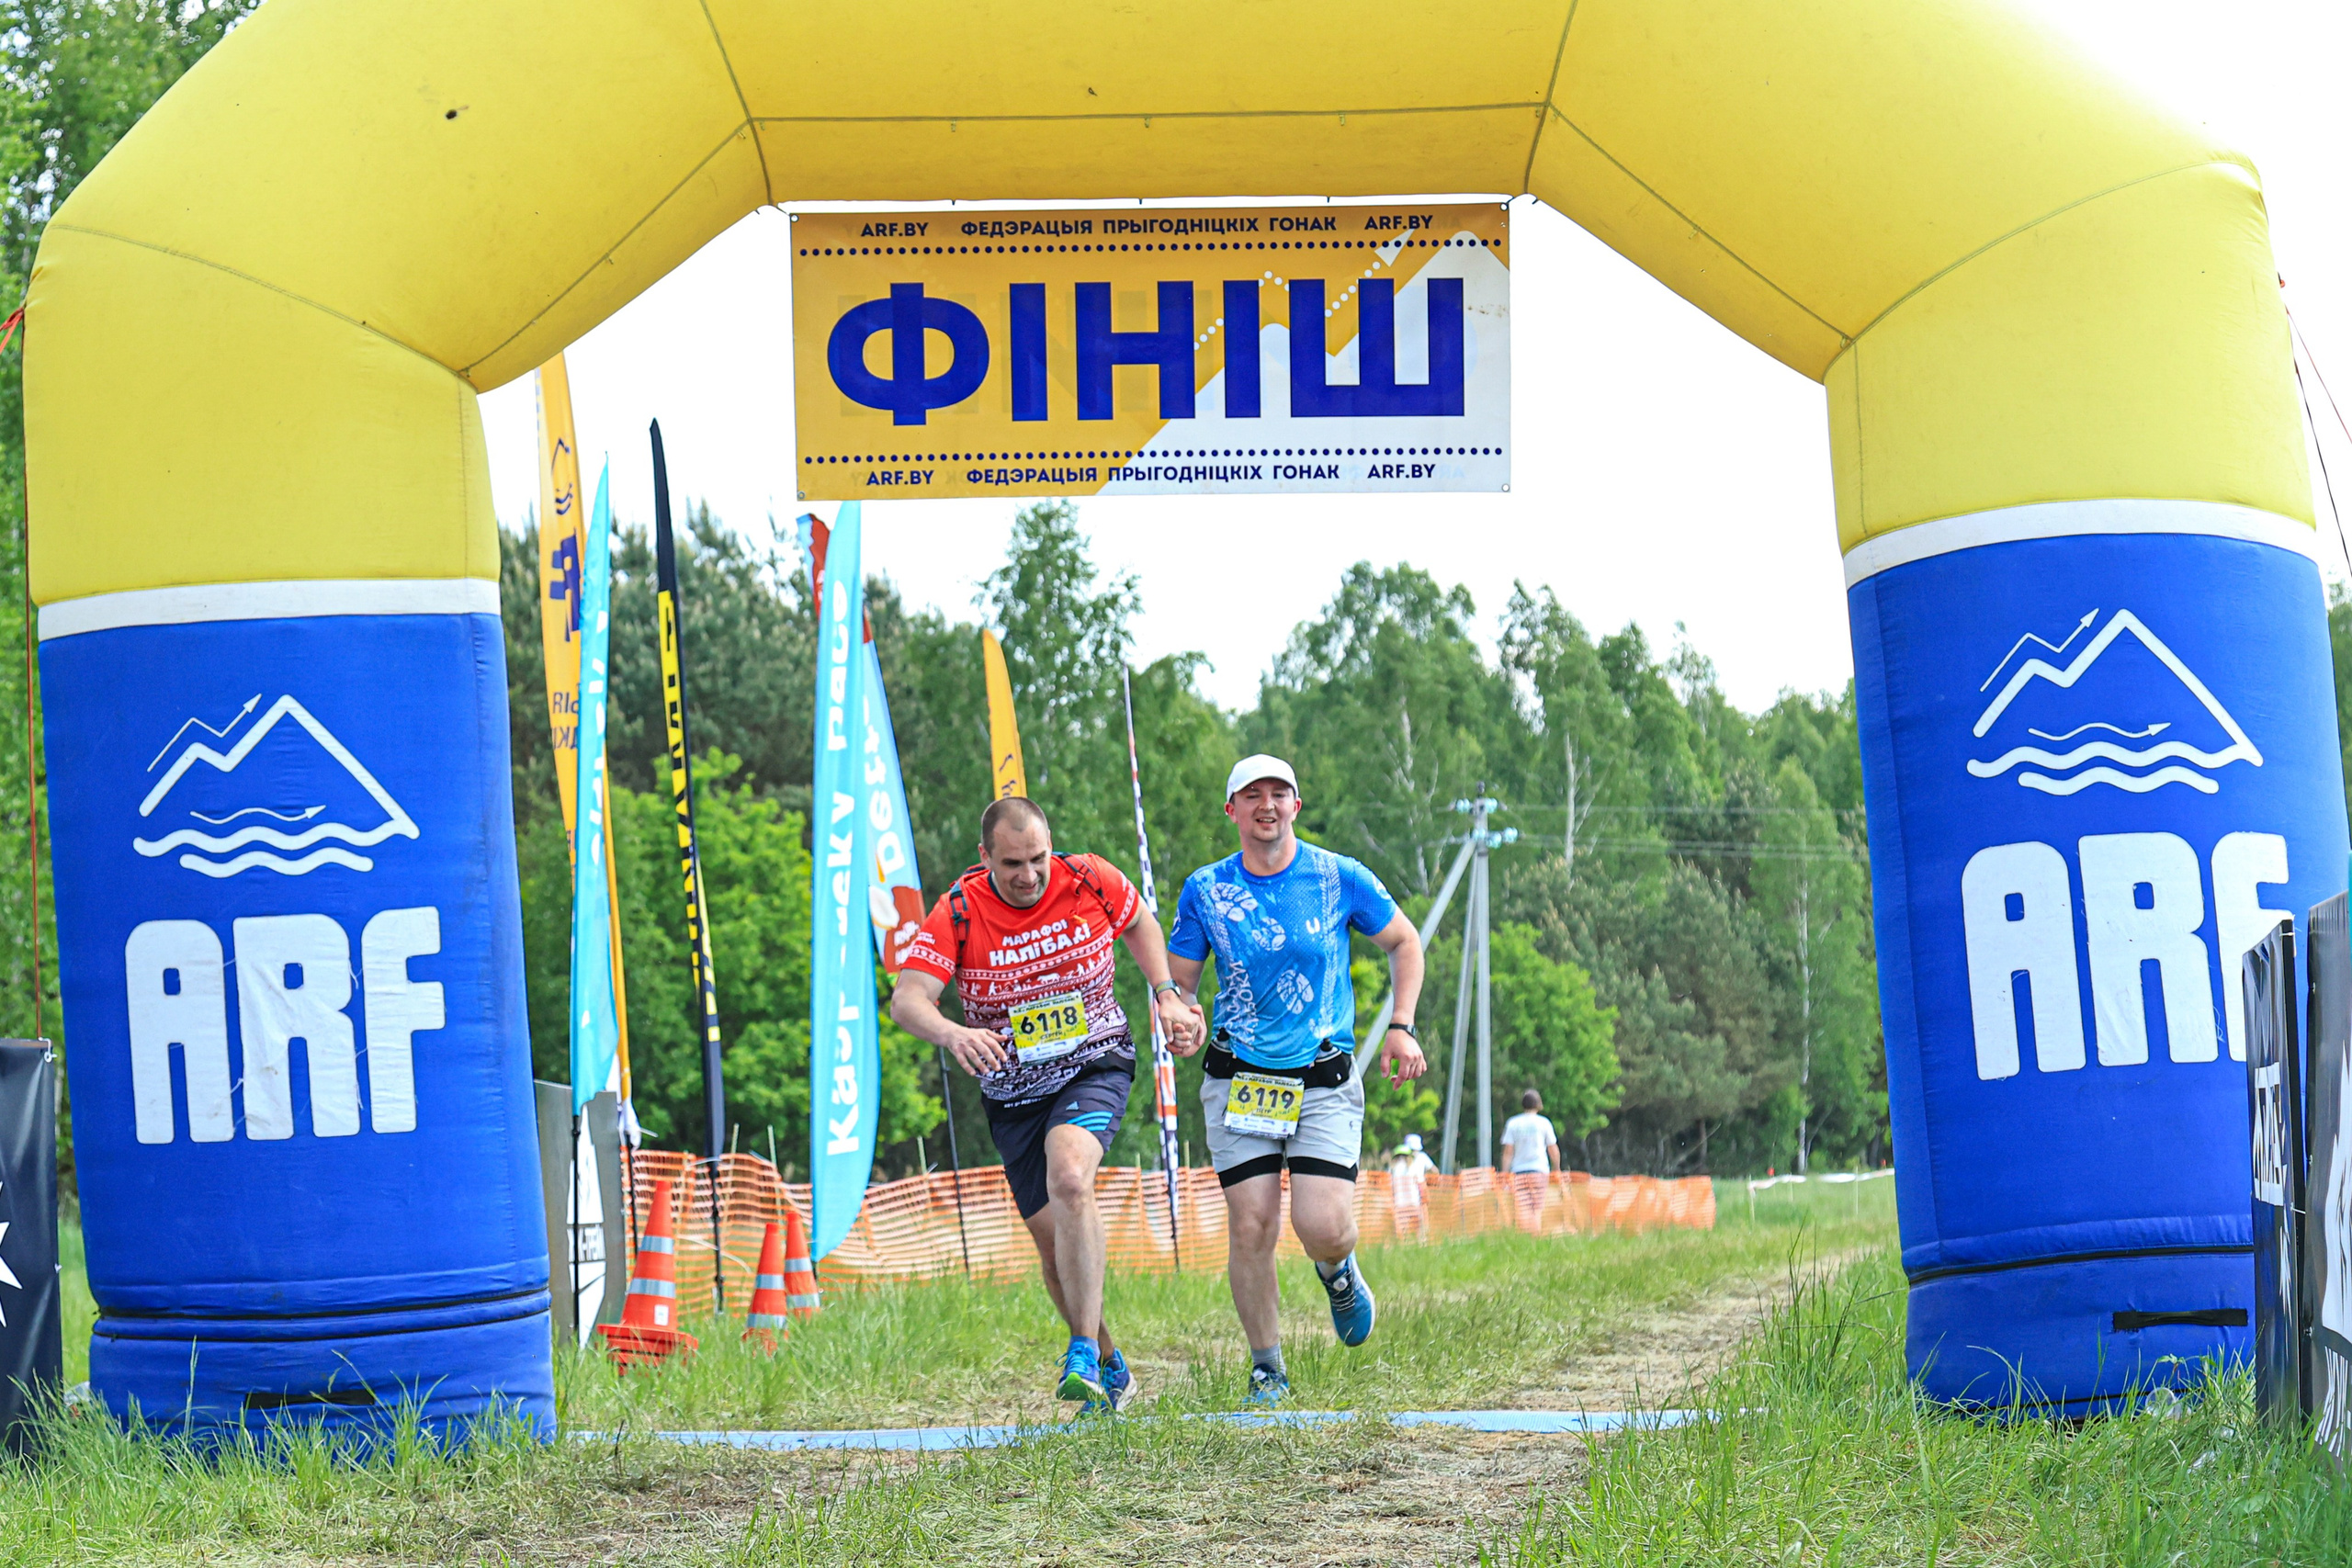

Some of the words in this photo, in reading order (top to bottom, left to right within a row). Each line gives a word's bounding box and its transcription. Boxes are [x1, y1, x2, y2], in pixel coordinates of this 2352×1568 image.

[861, 221, 929, 237] ARF.BY
[960, 220, 1093, 239] ФЕДЭРАЦЫЯ
[1102, 217, 1260, 235] ПРЫГОДНІЦКІХ
[1269, 216, 1337, 232] ГОНАК
[1364, 214, 1434, 231] ARF.BY
[827, 276, 1465, 427] ФІНІШ
[866, 469, 935, 486] ARF.BY
[966, 467, 1098, 487] ФЕДЭРАЦЫЯ
[1107, 465, 1263, 484] ПРЫГОДНІЦКІХ
[1272, 464, 1340, 480] ГОНАК
[1367, 463, 1436, 479] ARF.BY
[1961, 830, 2296, 1082] ARF
[124, 906, 447, 1145] ARF
[1020, 1006, 1078, 1035] 6118
[1238, 1084, 1295, 1110] 6119
